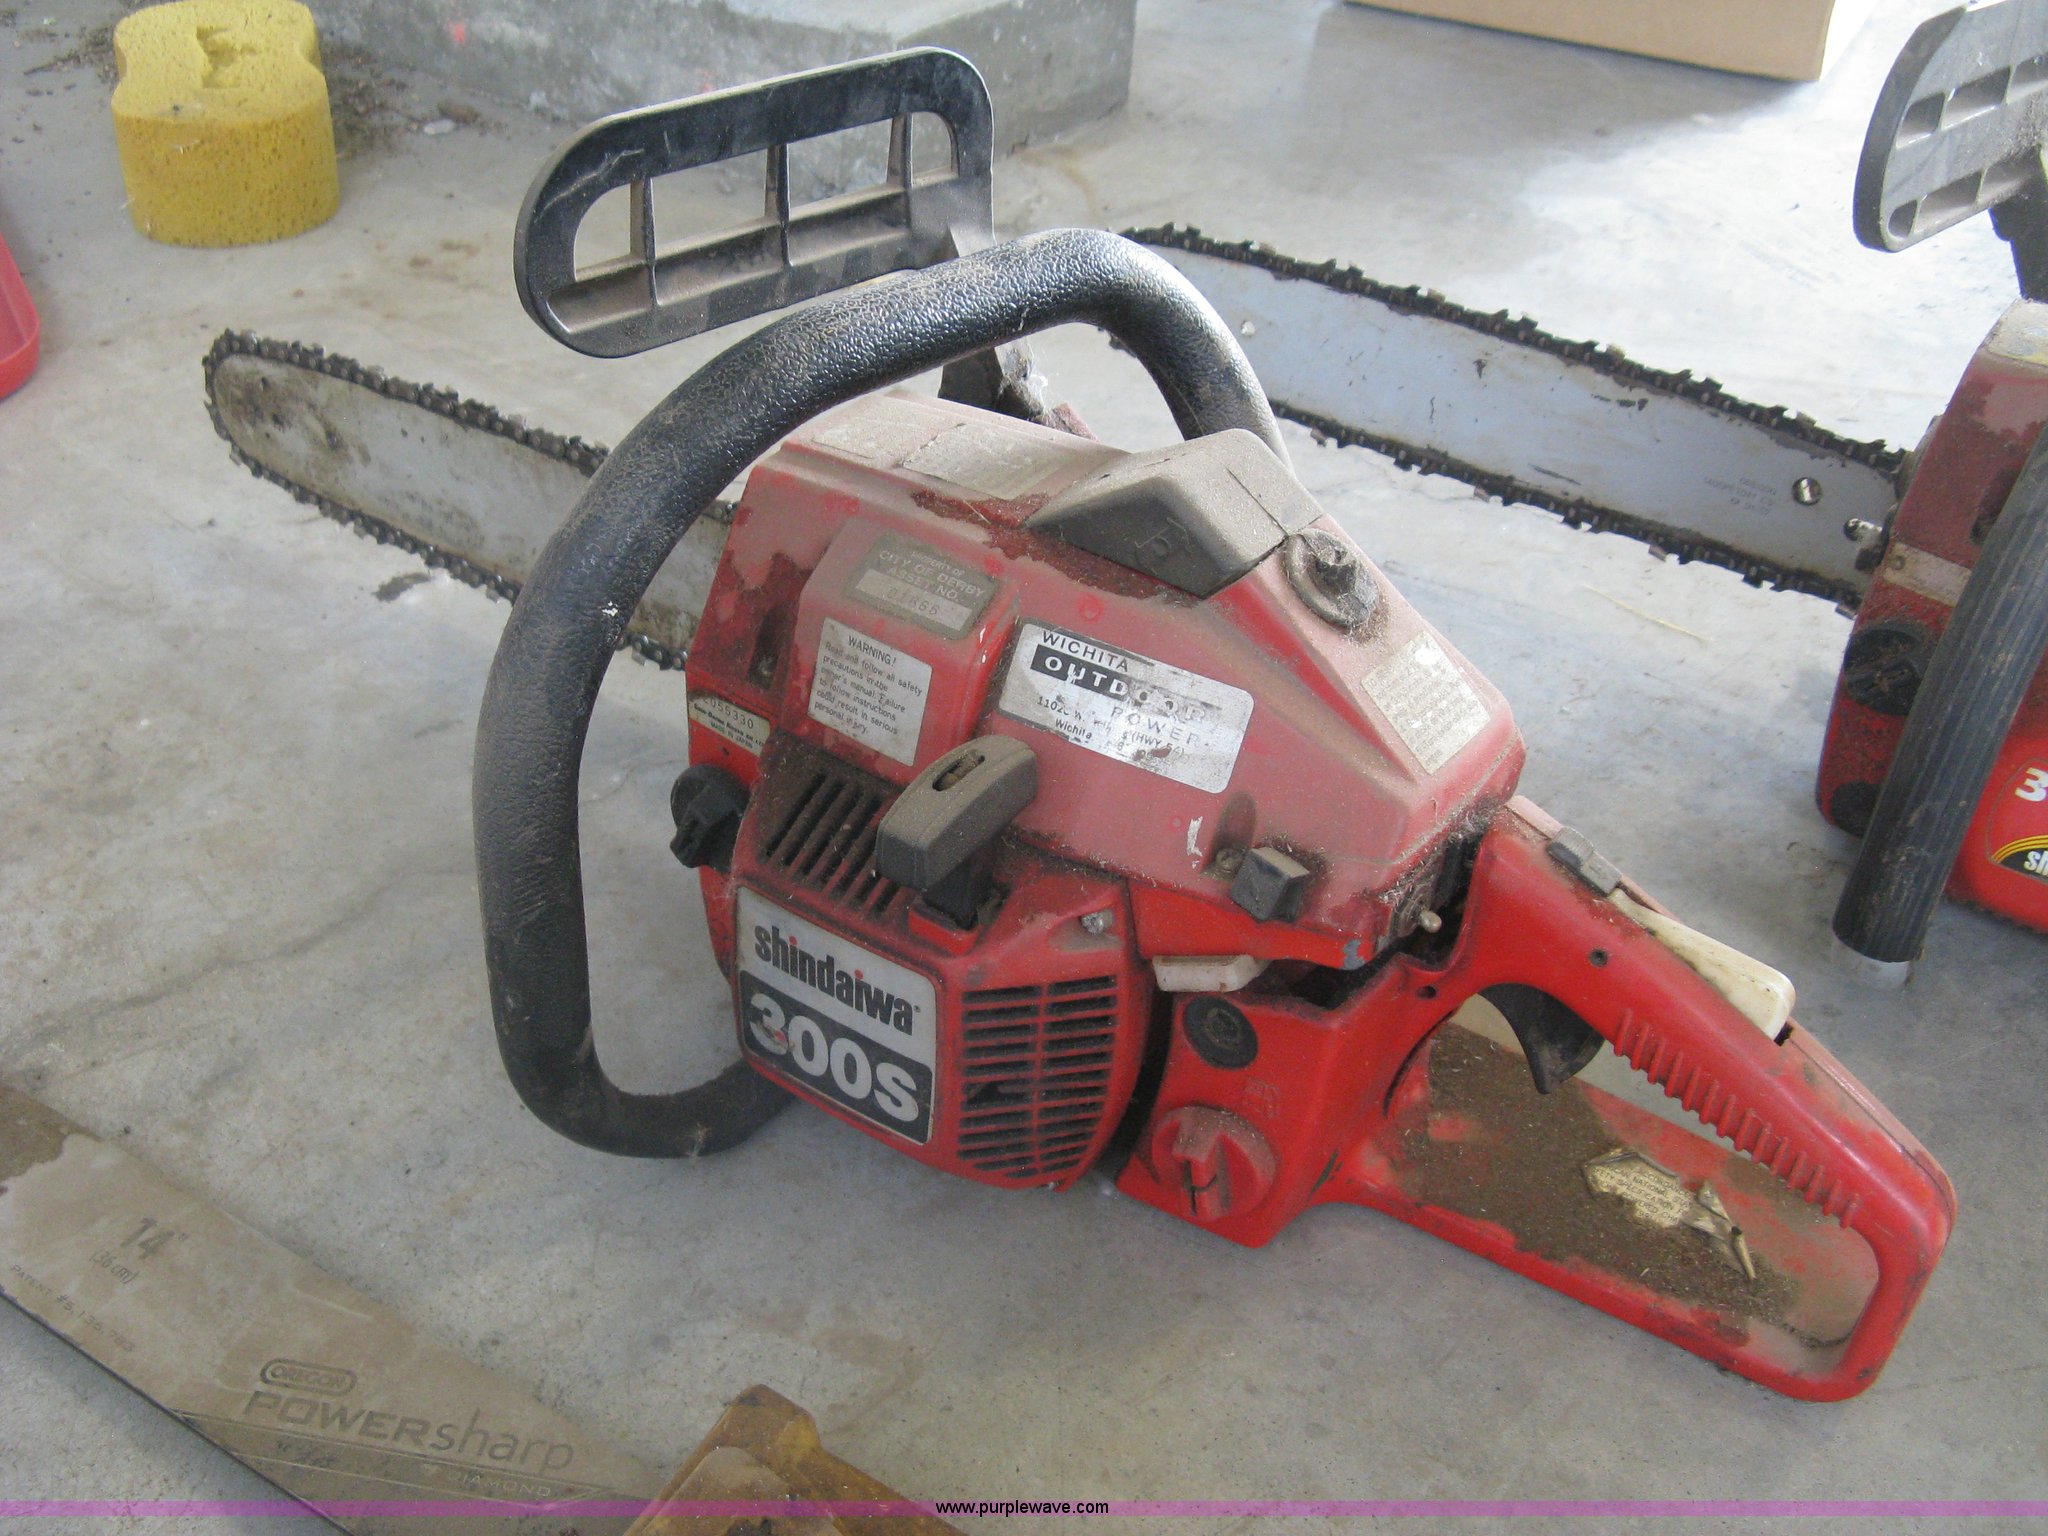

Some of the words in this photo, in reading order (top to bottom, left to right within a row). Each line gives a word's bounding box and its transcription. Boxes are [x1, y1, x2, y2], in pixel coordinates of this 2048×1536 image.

[880, 550, 911, 566] CITY
[914, 564, 934, 576] OF
[937, 573, 986, 597] DERBY
[886, 567, 931, 589] ASSET
[822, 655, 864, 680] precautions
[848, 635, 897, 668] WARNING!
[1042, 631, 1129, 673] WICHITA
[862, 659, 883, 677] follow
[886, 671, 896, 682] all
[898, 679, 922, 697] safety
[813, 701, 845, 721] personal
[829, 683, 851, 699] follow
[852, 694, 897, 723] instructions
[838, 699, 859, 717] result
[860, 710, 869, 721] in
[870, 716, 899, 736] serious
[754, 925, 914, 1037] shindaiwa
